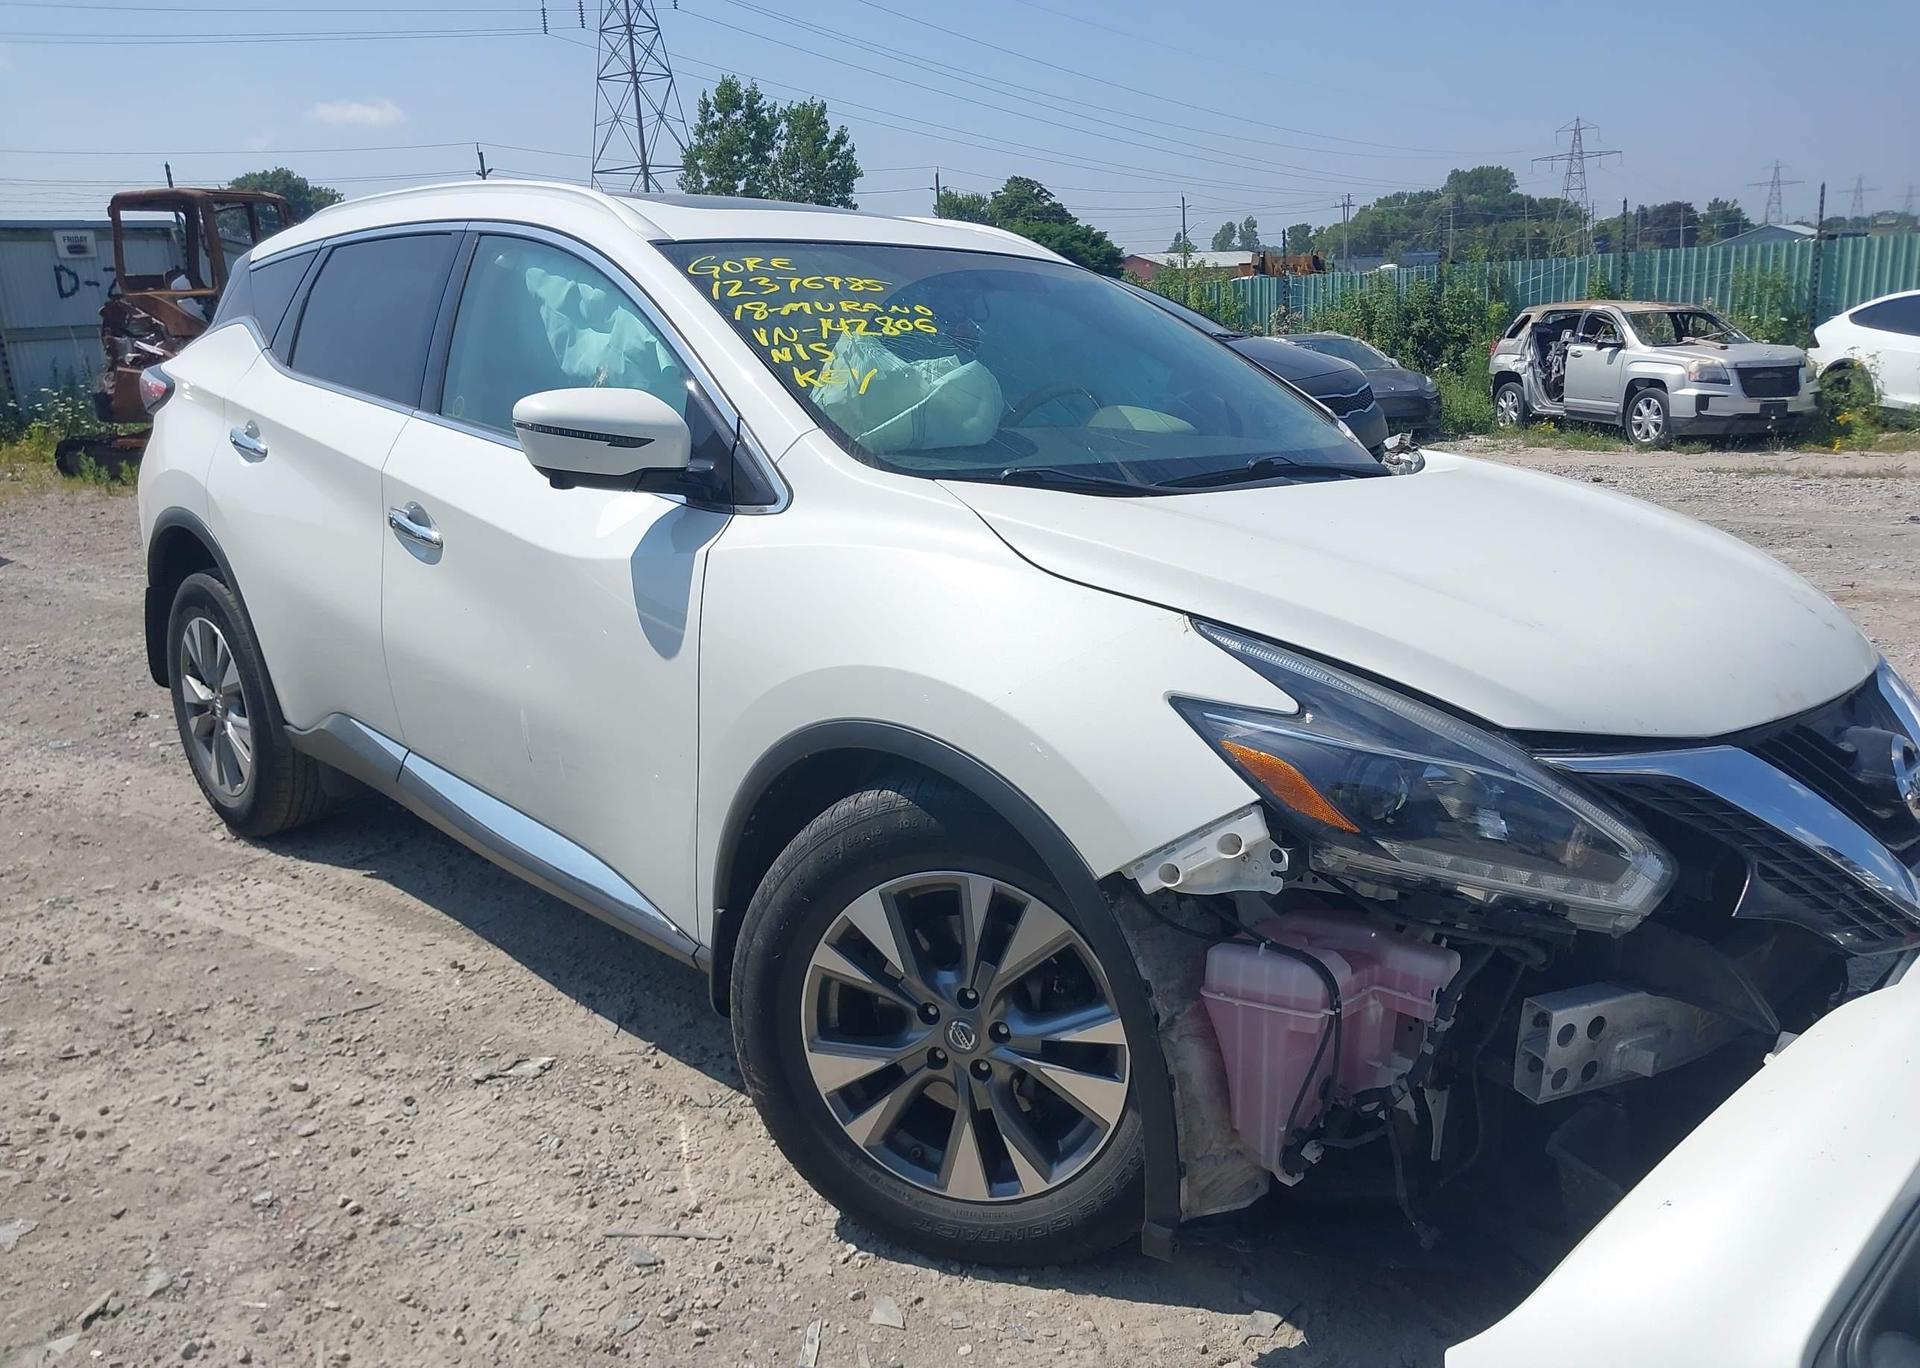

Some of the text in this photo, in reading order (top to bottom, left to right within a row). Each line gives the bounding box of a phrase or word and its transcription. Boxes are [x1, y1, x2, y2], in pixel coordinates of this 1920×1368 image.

[688, 255, 796, 279] GORE
[711, 276, 893, 300] 12376985
[734, 300, 934, 321] 18-MURANO
[770, 342, 837, 364] NIS
[793, 367, 878, 395] KEY
